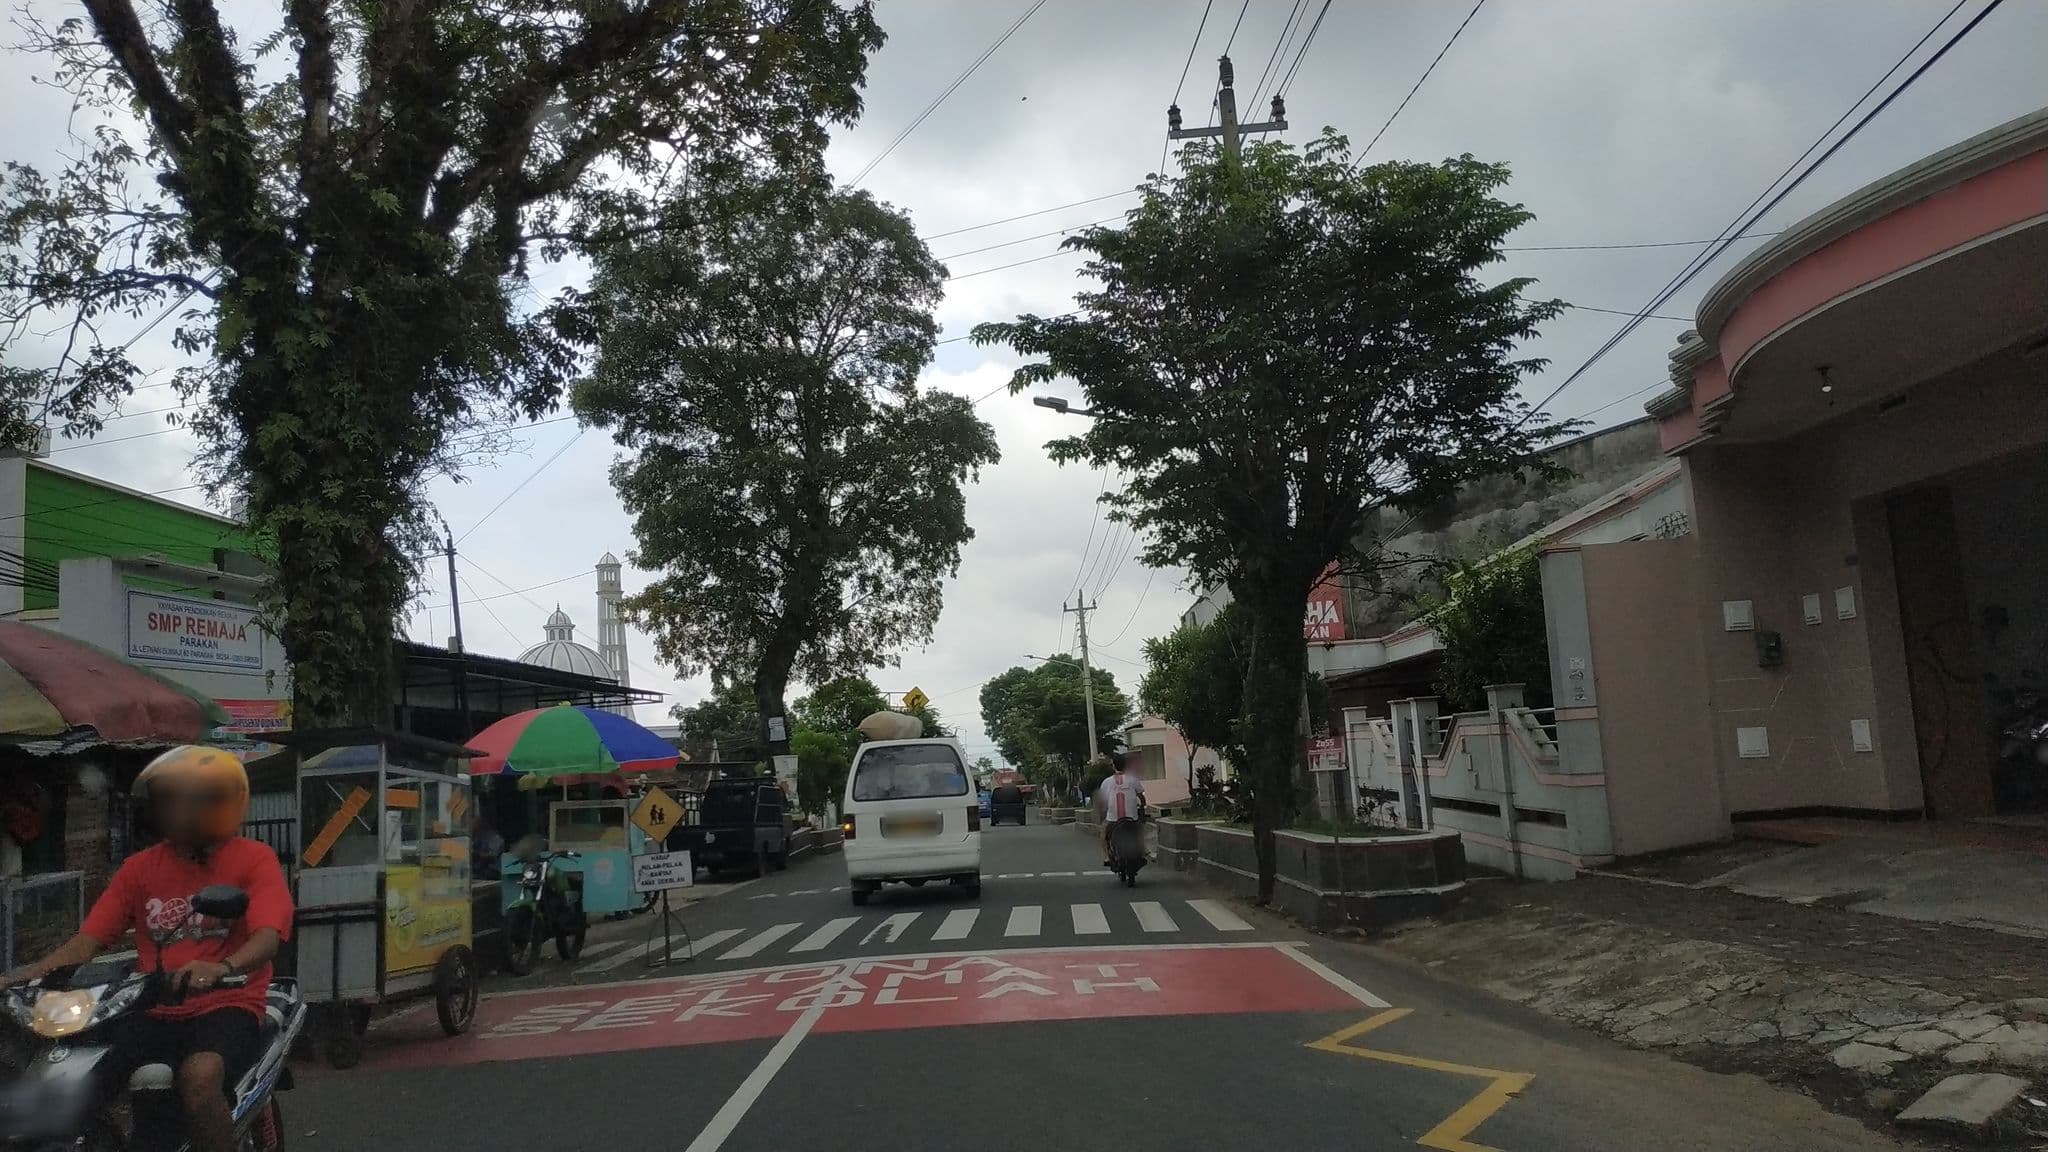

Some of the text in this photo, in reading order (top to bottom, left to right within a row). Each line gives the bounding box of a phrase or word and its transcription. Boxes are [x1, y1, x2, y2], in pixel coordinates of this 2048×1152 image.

[148, 612, 247, 642] SMP REMAJA
[180, 636, 218, 649] PARAKAN
[510, 962, 1140, 1021] SELAMAT
[675, 956, 1011, 993] ZONA
[478, 975, 1161, 1039] SEKOLAH
